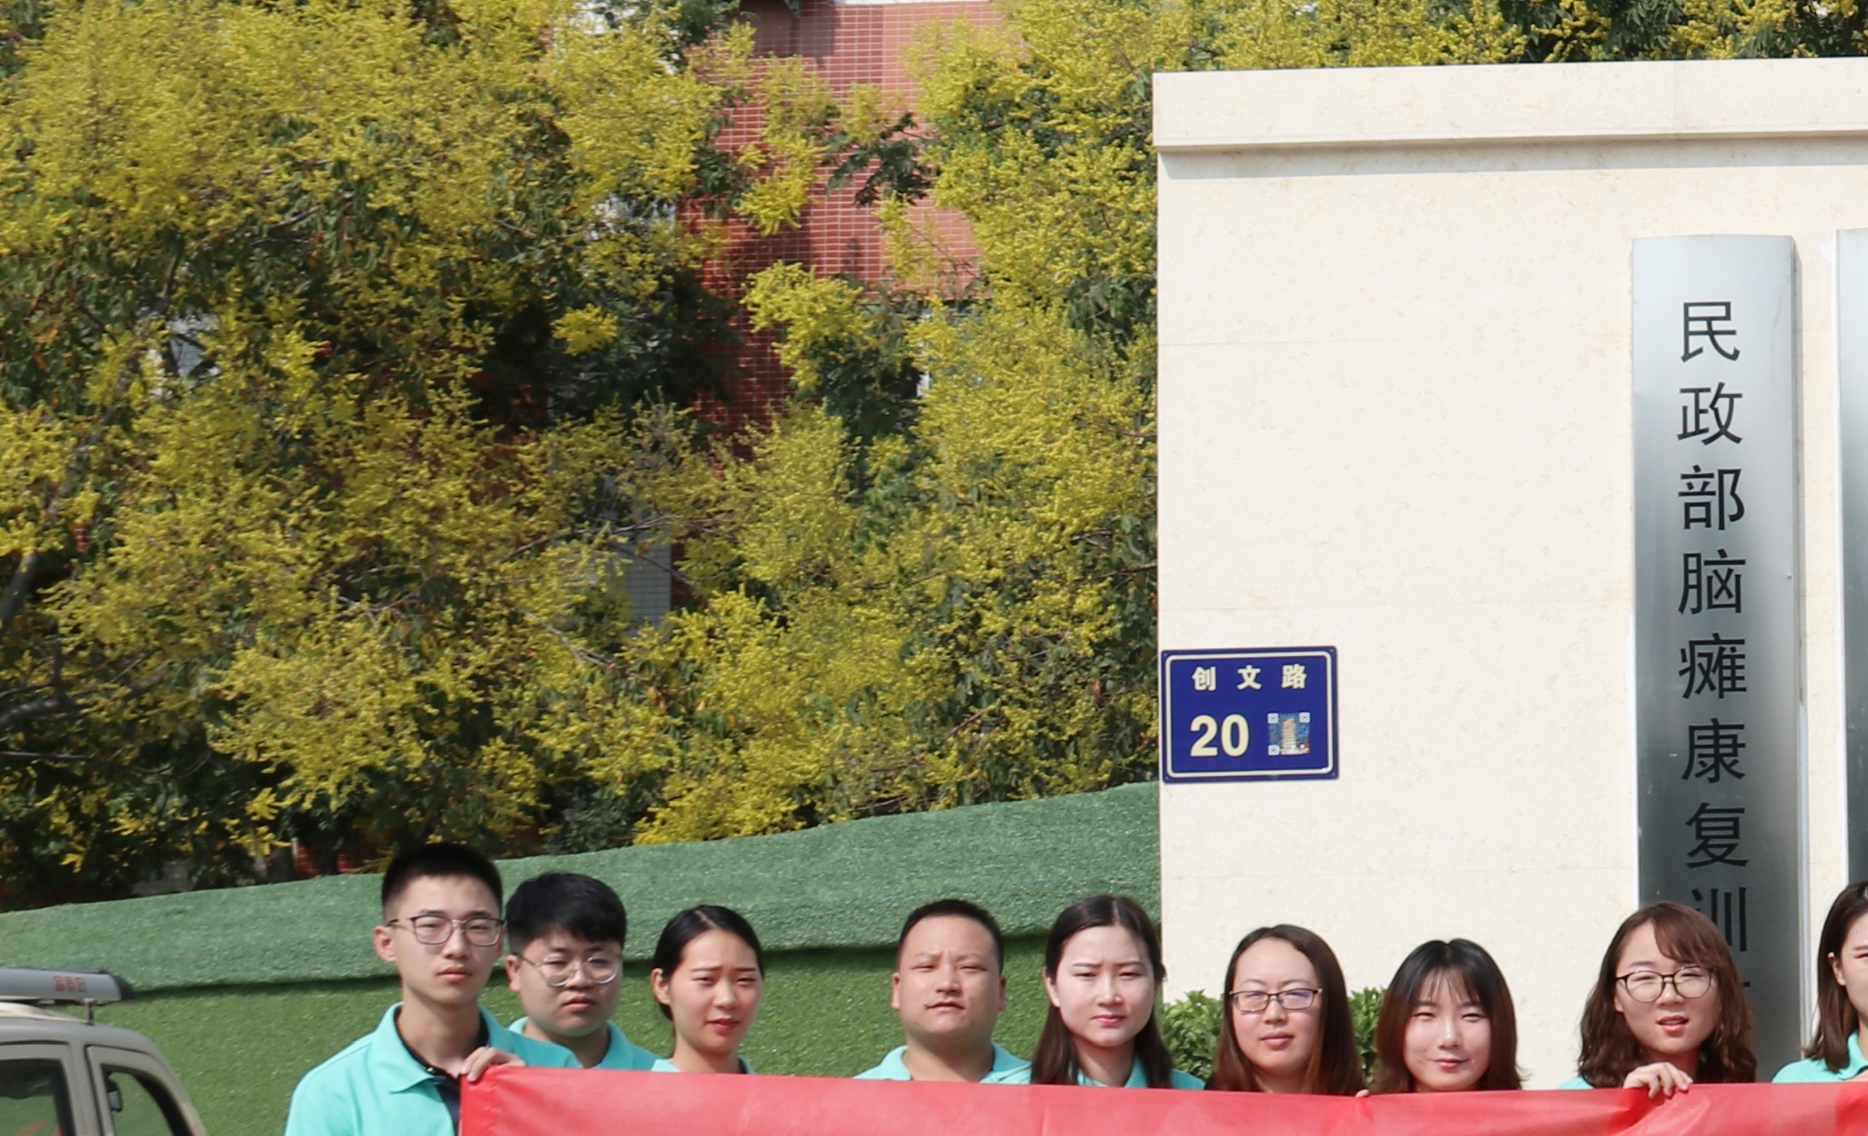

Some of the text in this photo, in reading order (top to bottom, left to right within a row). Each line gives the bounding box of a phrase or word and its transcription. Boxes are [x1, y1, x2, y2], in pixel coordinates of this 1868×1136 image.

[1677, 300, 1751, 988] 民政部脑瘫康复训
[1191, 663, 1307, 691] 创文路
[1190, 714, 1249, 757] 20
